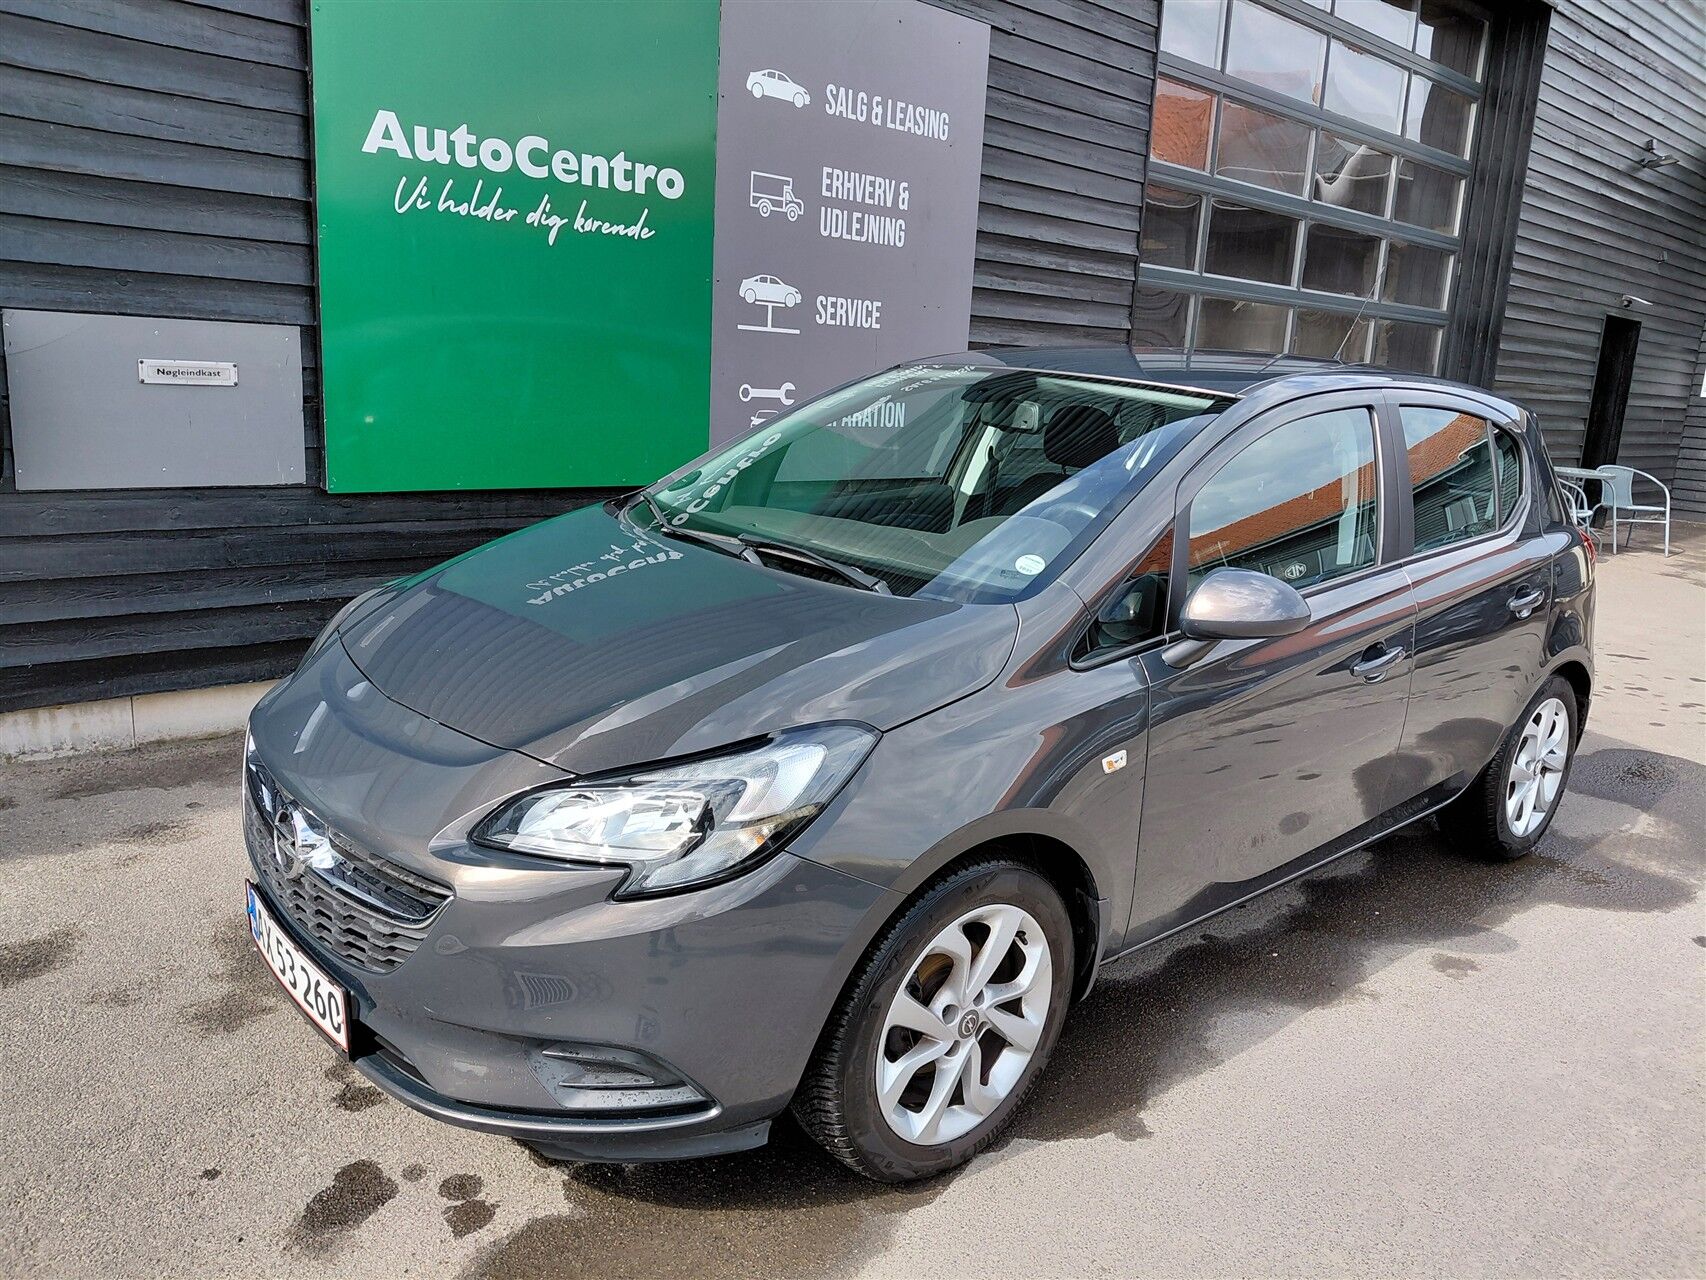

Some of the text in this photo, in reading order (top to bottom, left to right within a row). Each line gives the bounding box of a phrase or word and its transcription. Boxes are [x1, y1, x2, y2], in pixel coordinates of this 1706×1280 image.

[825, 83, 949, 141] SALG & LEASING
[361, 109, 685, 200] AutoCentro
[394, 176, 431, 213] Vi
[437, 179, 518, 222] holder
[525, 193, 569, 246] dig
[822, 166, 909, 210] ERHVERV &
[820, 206, 905, 247] UDLEJNING
[815, 295, 882, 329] SERVICE
[156, 368, 221, 377] Nøgleindkast
[257, 909, 342, 1034] AX 53 260
